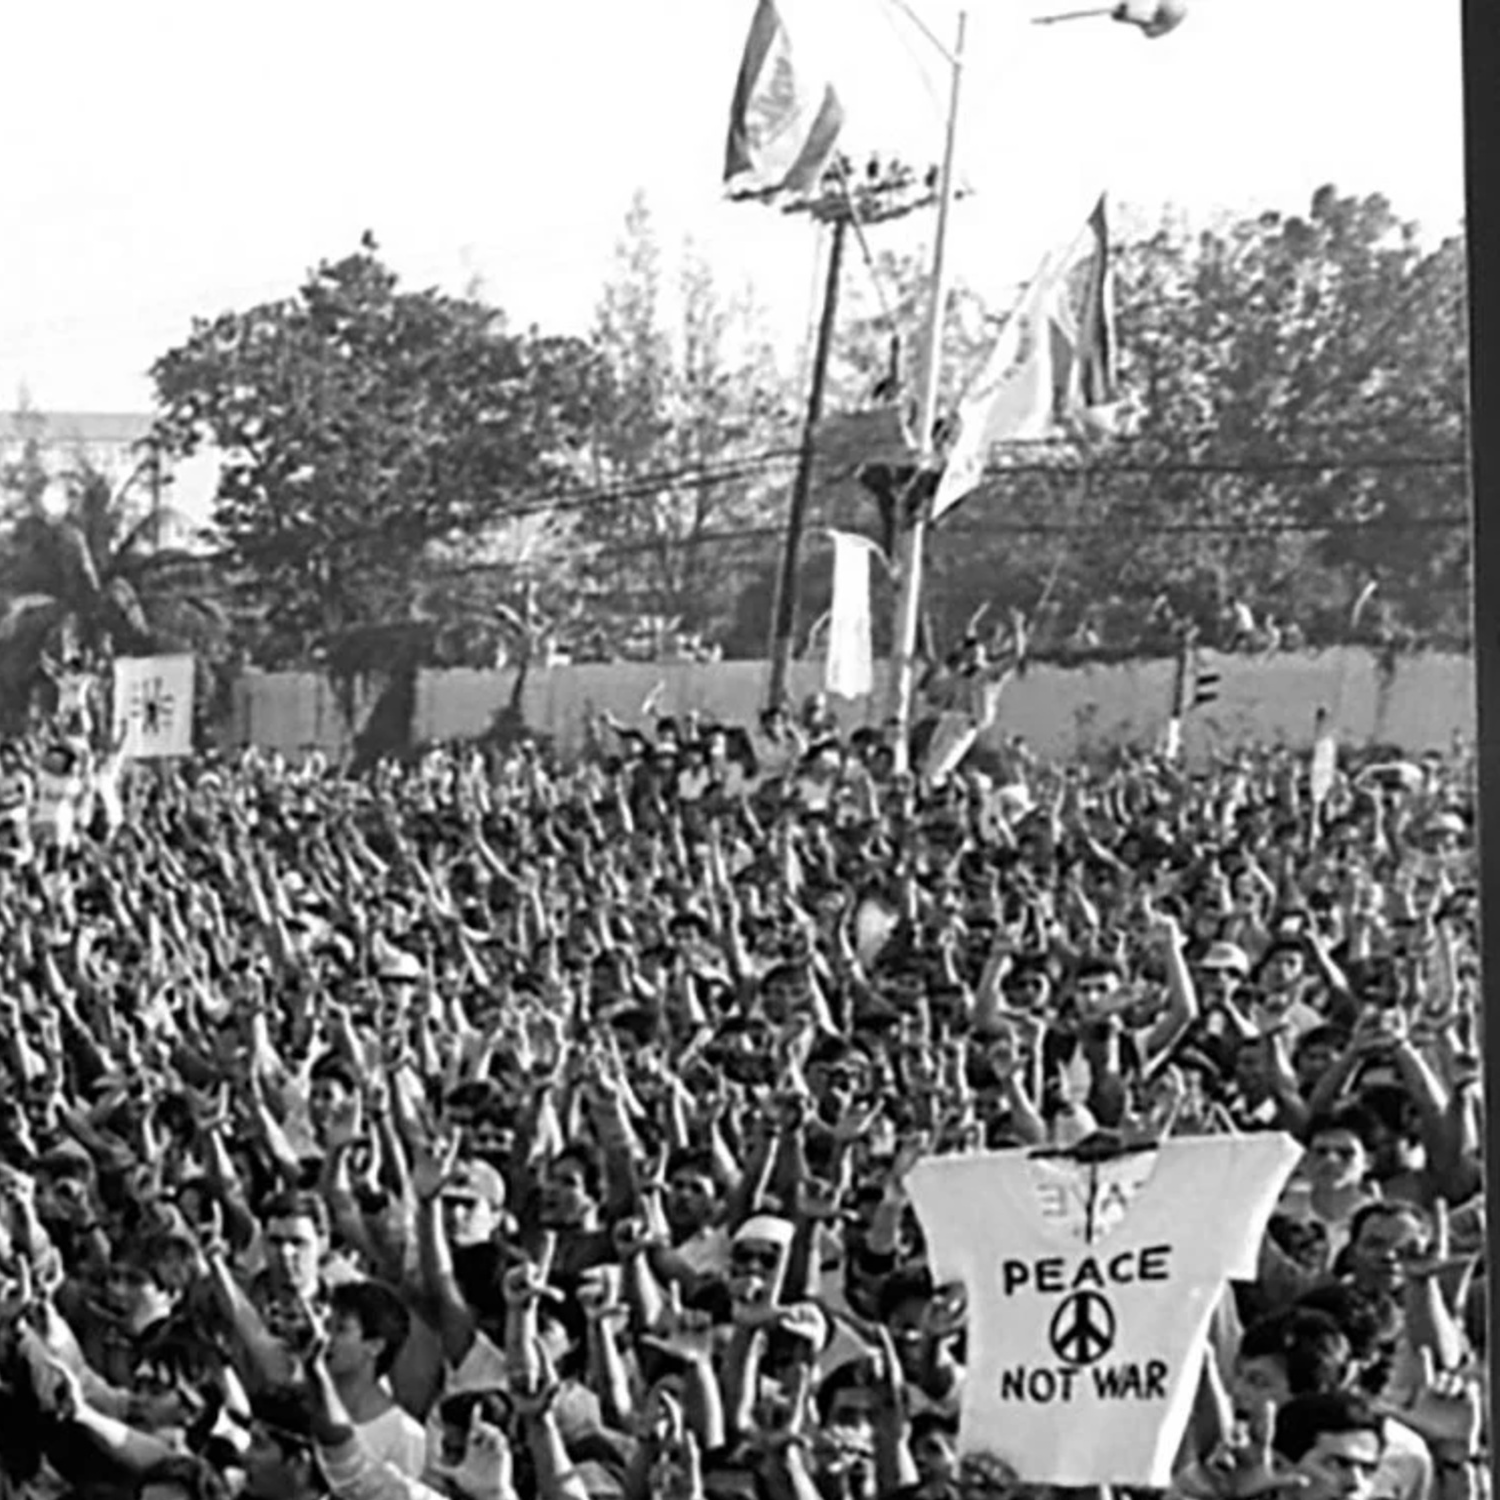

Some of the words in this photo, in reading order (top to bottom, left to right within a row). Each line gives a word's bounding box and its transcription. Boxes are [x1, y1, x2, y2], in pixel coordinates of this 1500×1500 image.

[1002, 1244, 1172, 1297] PEACE
[1001, 1366, 1080, 1404] NOT
[1092, 1359, 1168, 1400] WAR
